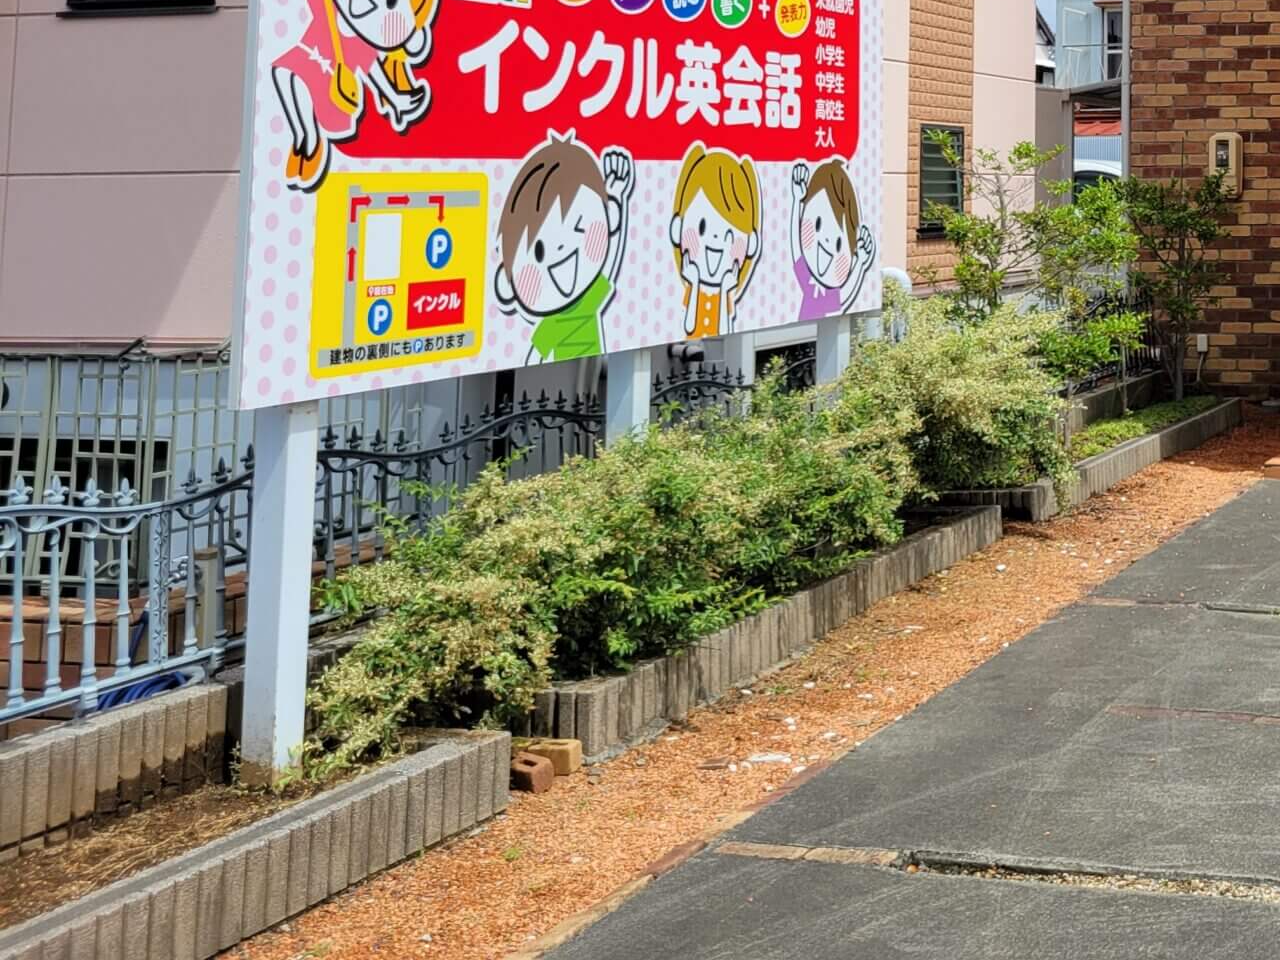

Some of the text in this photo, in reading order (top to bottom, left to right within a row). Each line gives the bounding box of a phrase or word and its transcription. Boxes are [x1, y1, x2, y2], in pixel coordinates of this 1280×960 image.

[815, 16, 836, 39] 幼児
[815, 43, 845, 68] 小学生
[458, 20, 802, 128] インクル英会話
[815, 71, 845, 94] 中学生
[815, 99, 845, 122] 高校生
[815, 125, 835, 148] 大人
[432, 234, 448, 262] P
[413, 292, 460, 314] インクル
[374, 304, 389, 331] P
